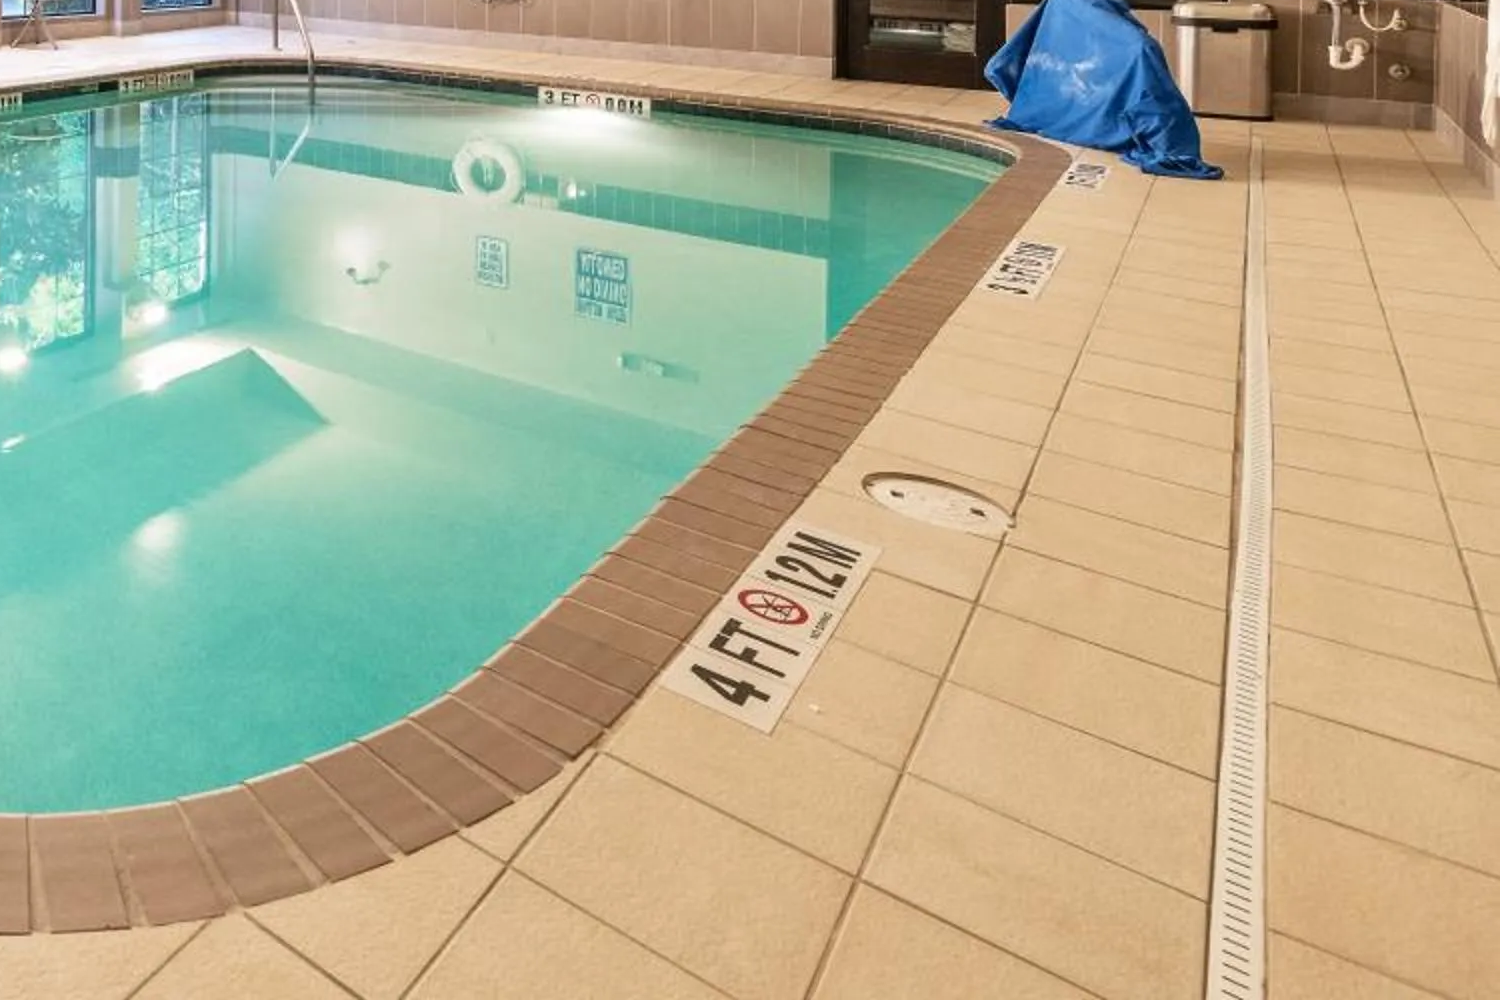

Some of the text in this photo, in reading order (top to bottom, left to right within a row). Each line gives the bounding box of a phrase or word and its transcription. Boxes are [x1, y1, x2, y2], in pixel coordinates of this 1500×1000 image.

[544, 90, 555, 104] 3
[708, 617, 801, 678] FT
[691, 663, 771, 707] 4
